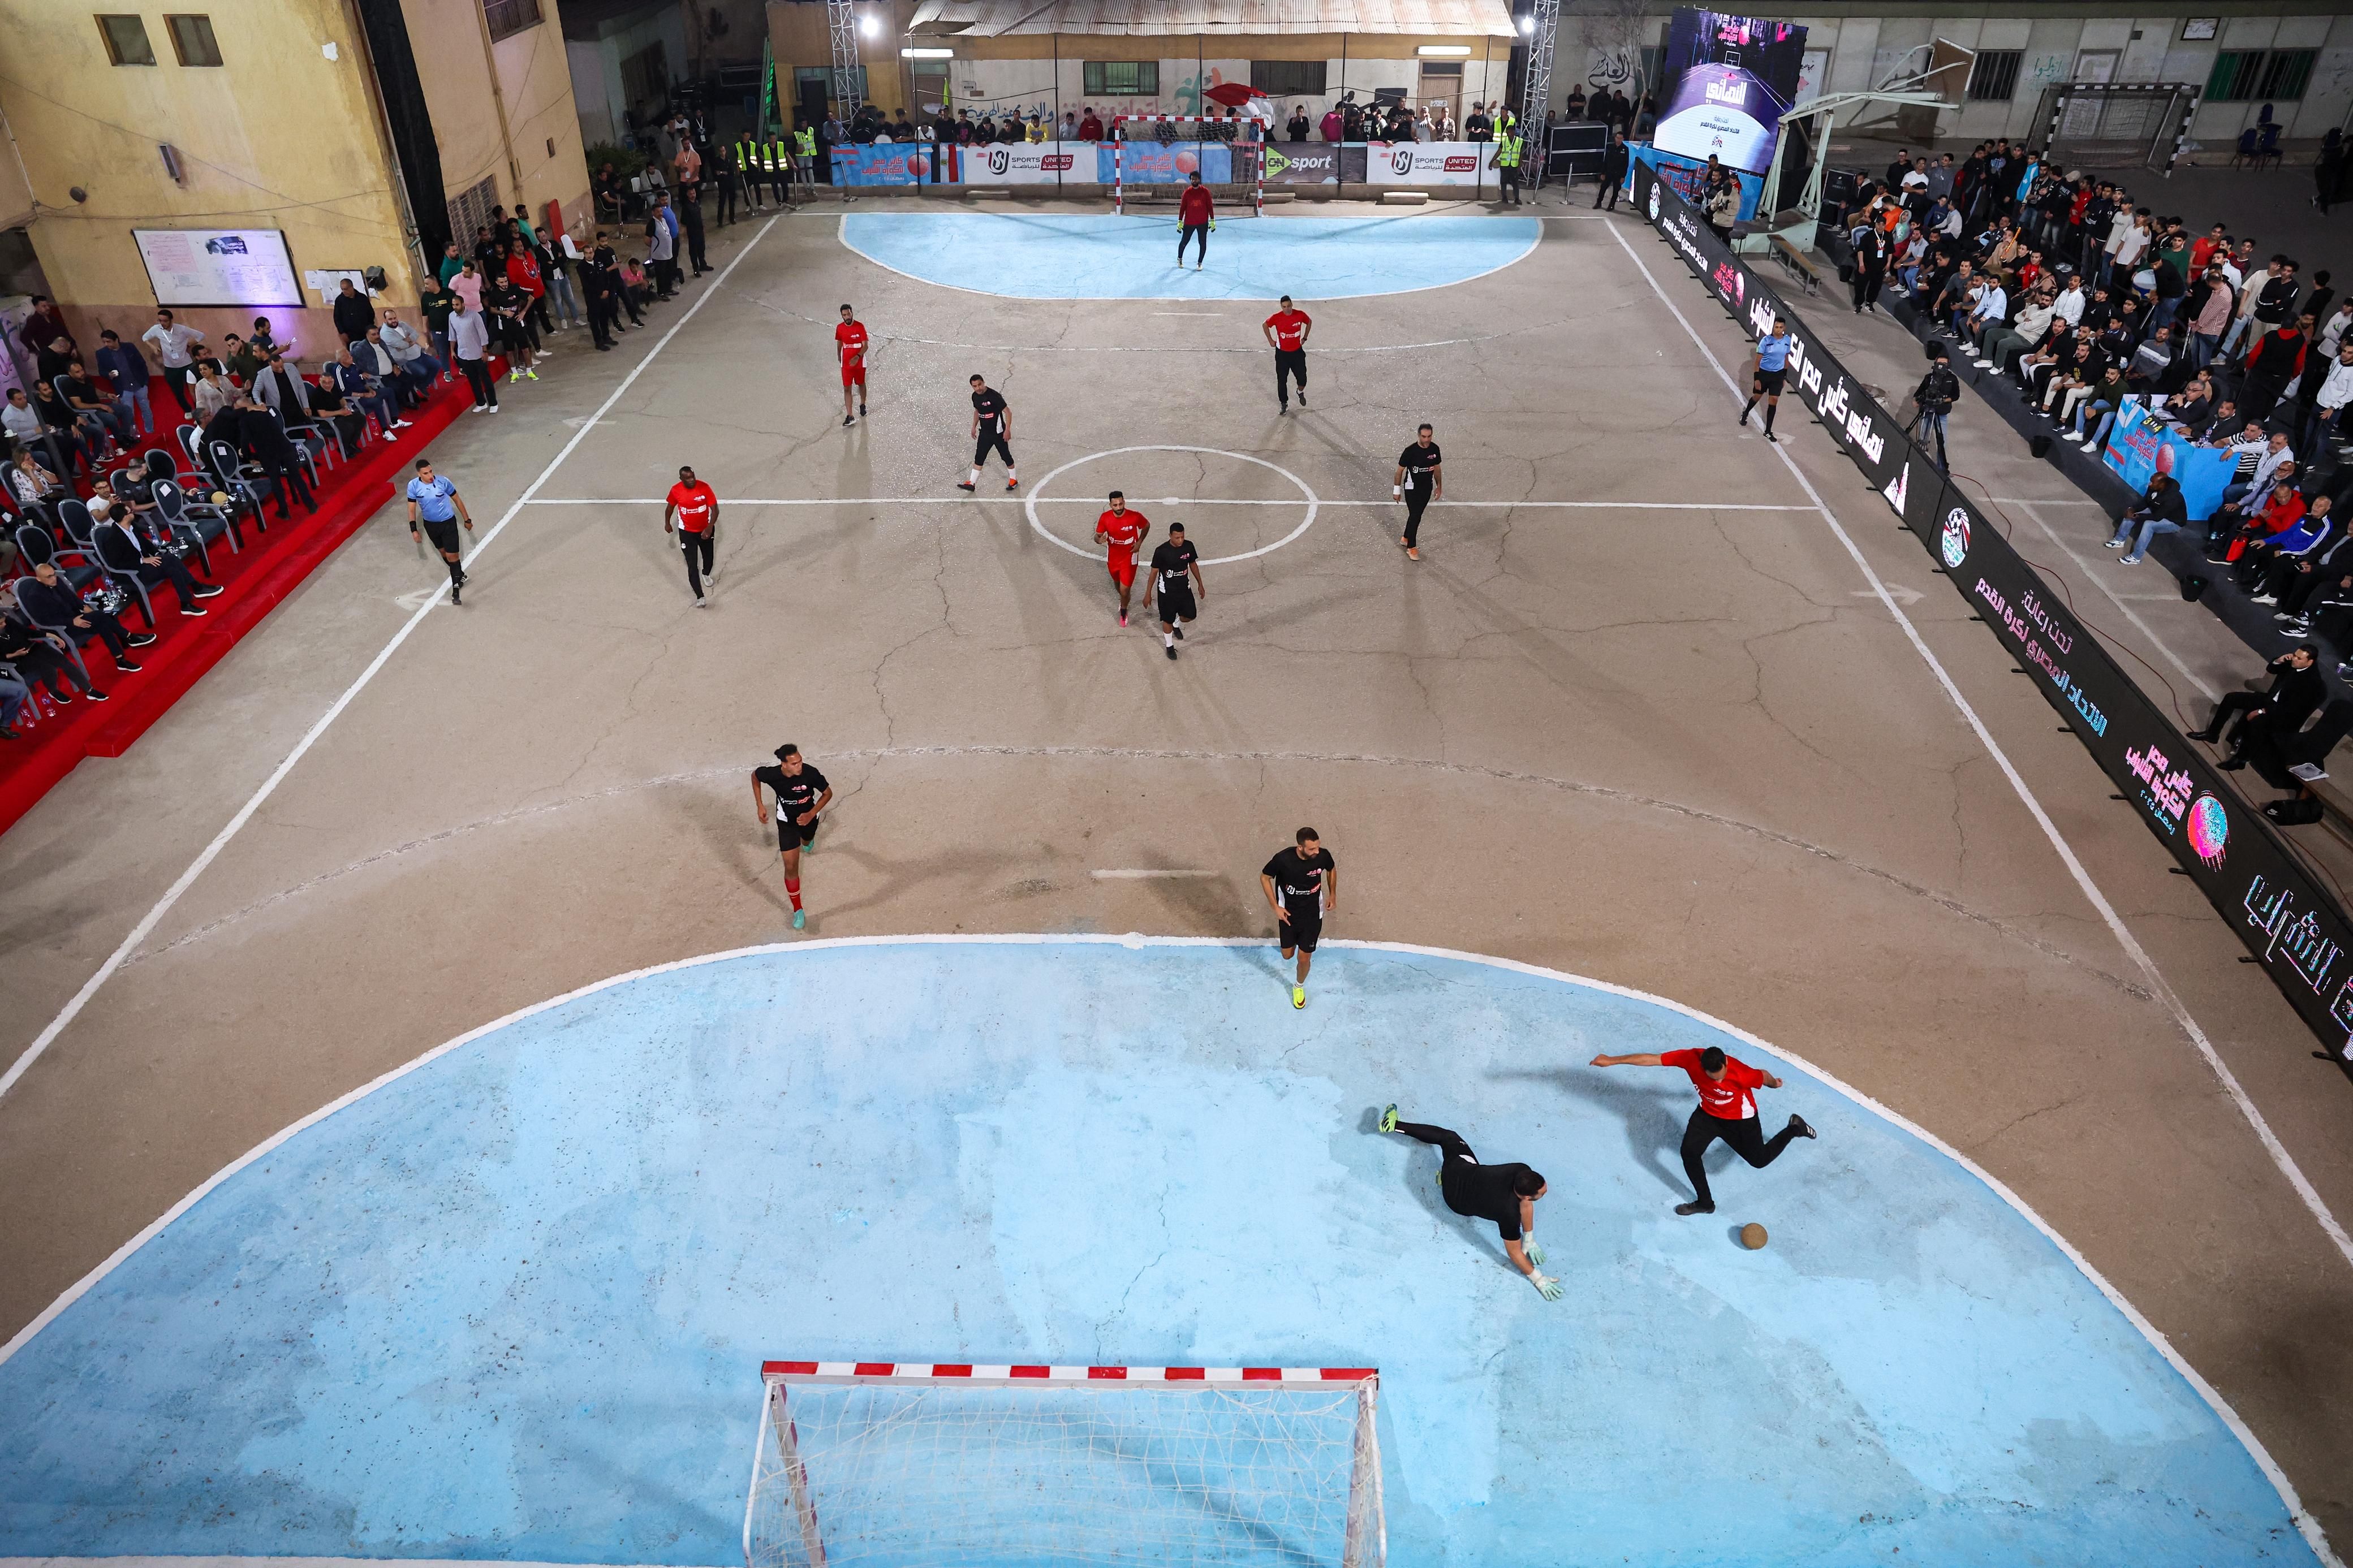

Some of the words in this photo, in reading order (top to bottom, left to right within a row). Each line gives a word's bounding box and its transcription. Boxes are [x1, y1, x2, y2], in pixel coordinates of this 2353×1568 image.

[1705, 79, 1748, 106] النهائي
[882, 166, 904, 176] للكورة
[1291, 155, 1332, 172] sport
[1662, 217, 1674, 234] القدم
[1673, 225, 1683, 243] لكرة
[1681, 237, 1697, 258] المصري
[1695, 252, 1708, 272] الاتحاد
[1799, 357, 1823, 395] مصر
[1817, 375, 1849, 425] كأس
[1846, 409, 1885, 465] نهائي
[2134, 427, 2145, 439] مصر
[1975, 577, 2006, 615] القدم
[2003, 606, 2030, 642] لكرة
[2048, 620, 2073, 654] تحت
[2026, 640, 2070, 692] المصري
[2067, 684, 2108, 737] الاتحاد
[2125, 746, 2155, 785] الشراب
[2145, 744, 2169, 775] مصر
[2151, 774, 2186, 821] للكورة
[2154, 807, 2176, 836] رمضان
